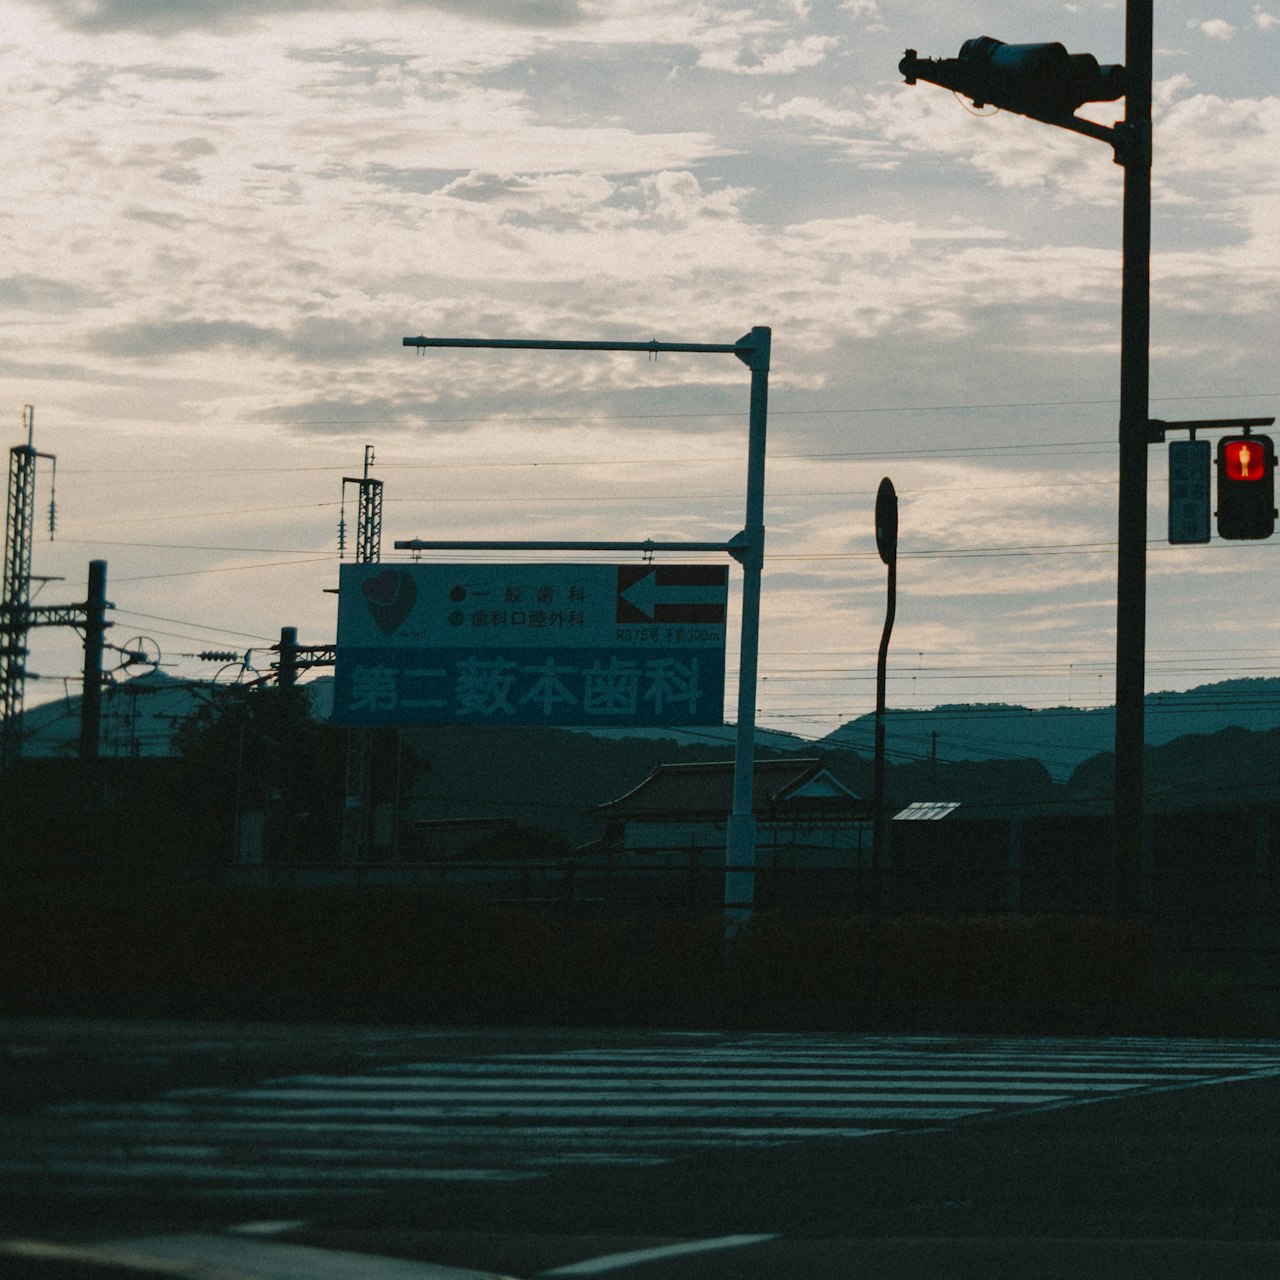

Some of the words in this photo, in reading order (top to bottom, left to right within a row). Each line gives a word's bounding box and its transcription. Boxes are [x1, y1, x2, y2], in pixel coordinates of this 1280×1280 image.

[471, 610, 584, 627] 歯科口腔外科
